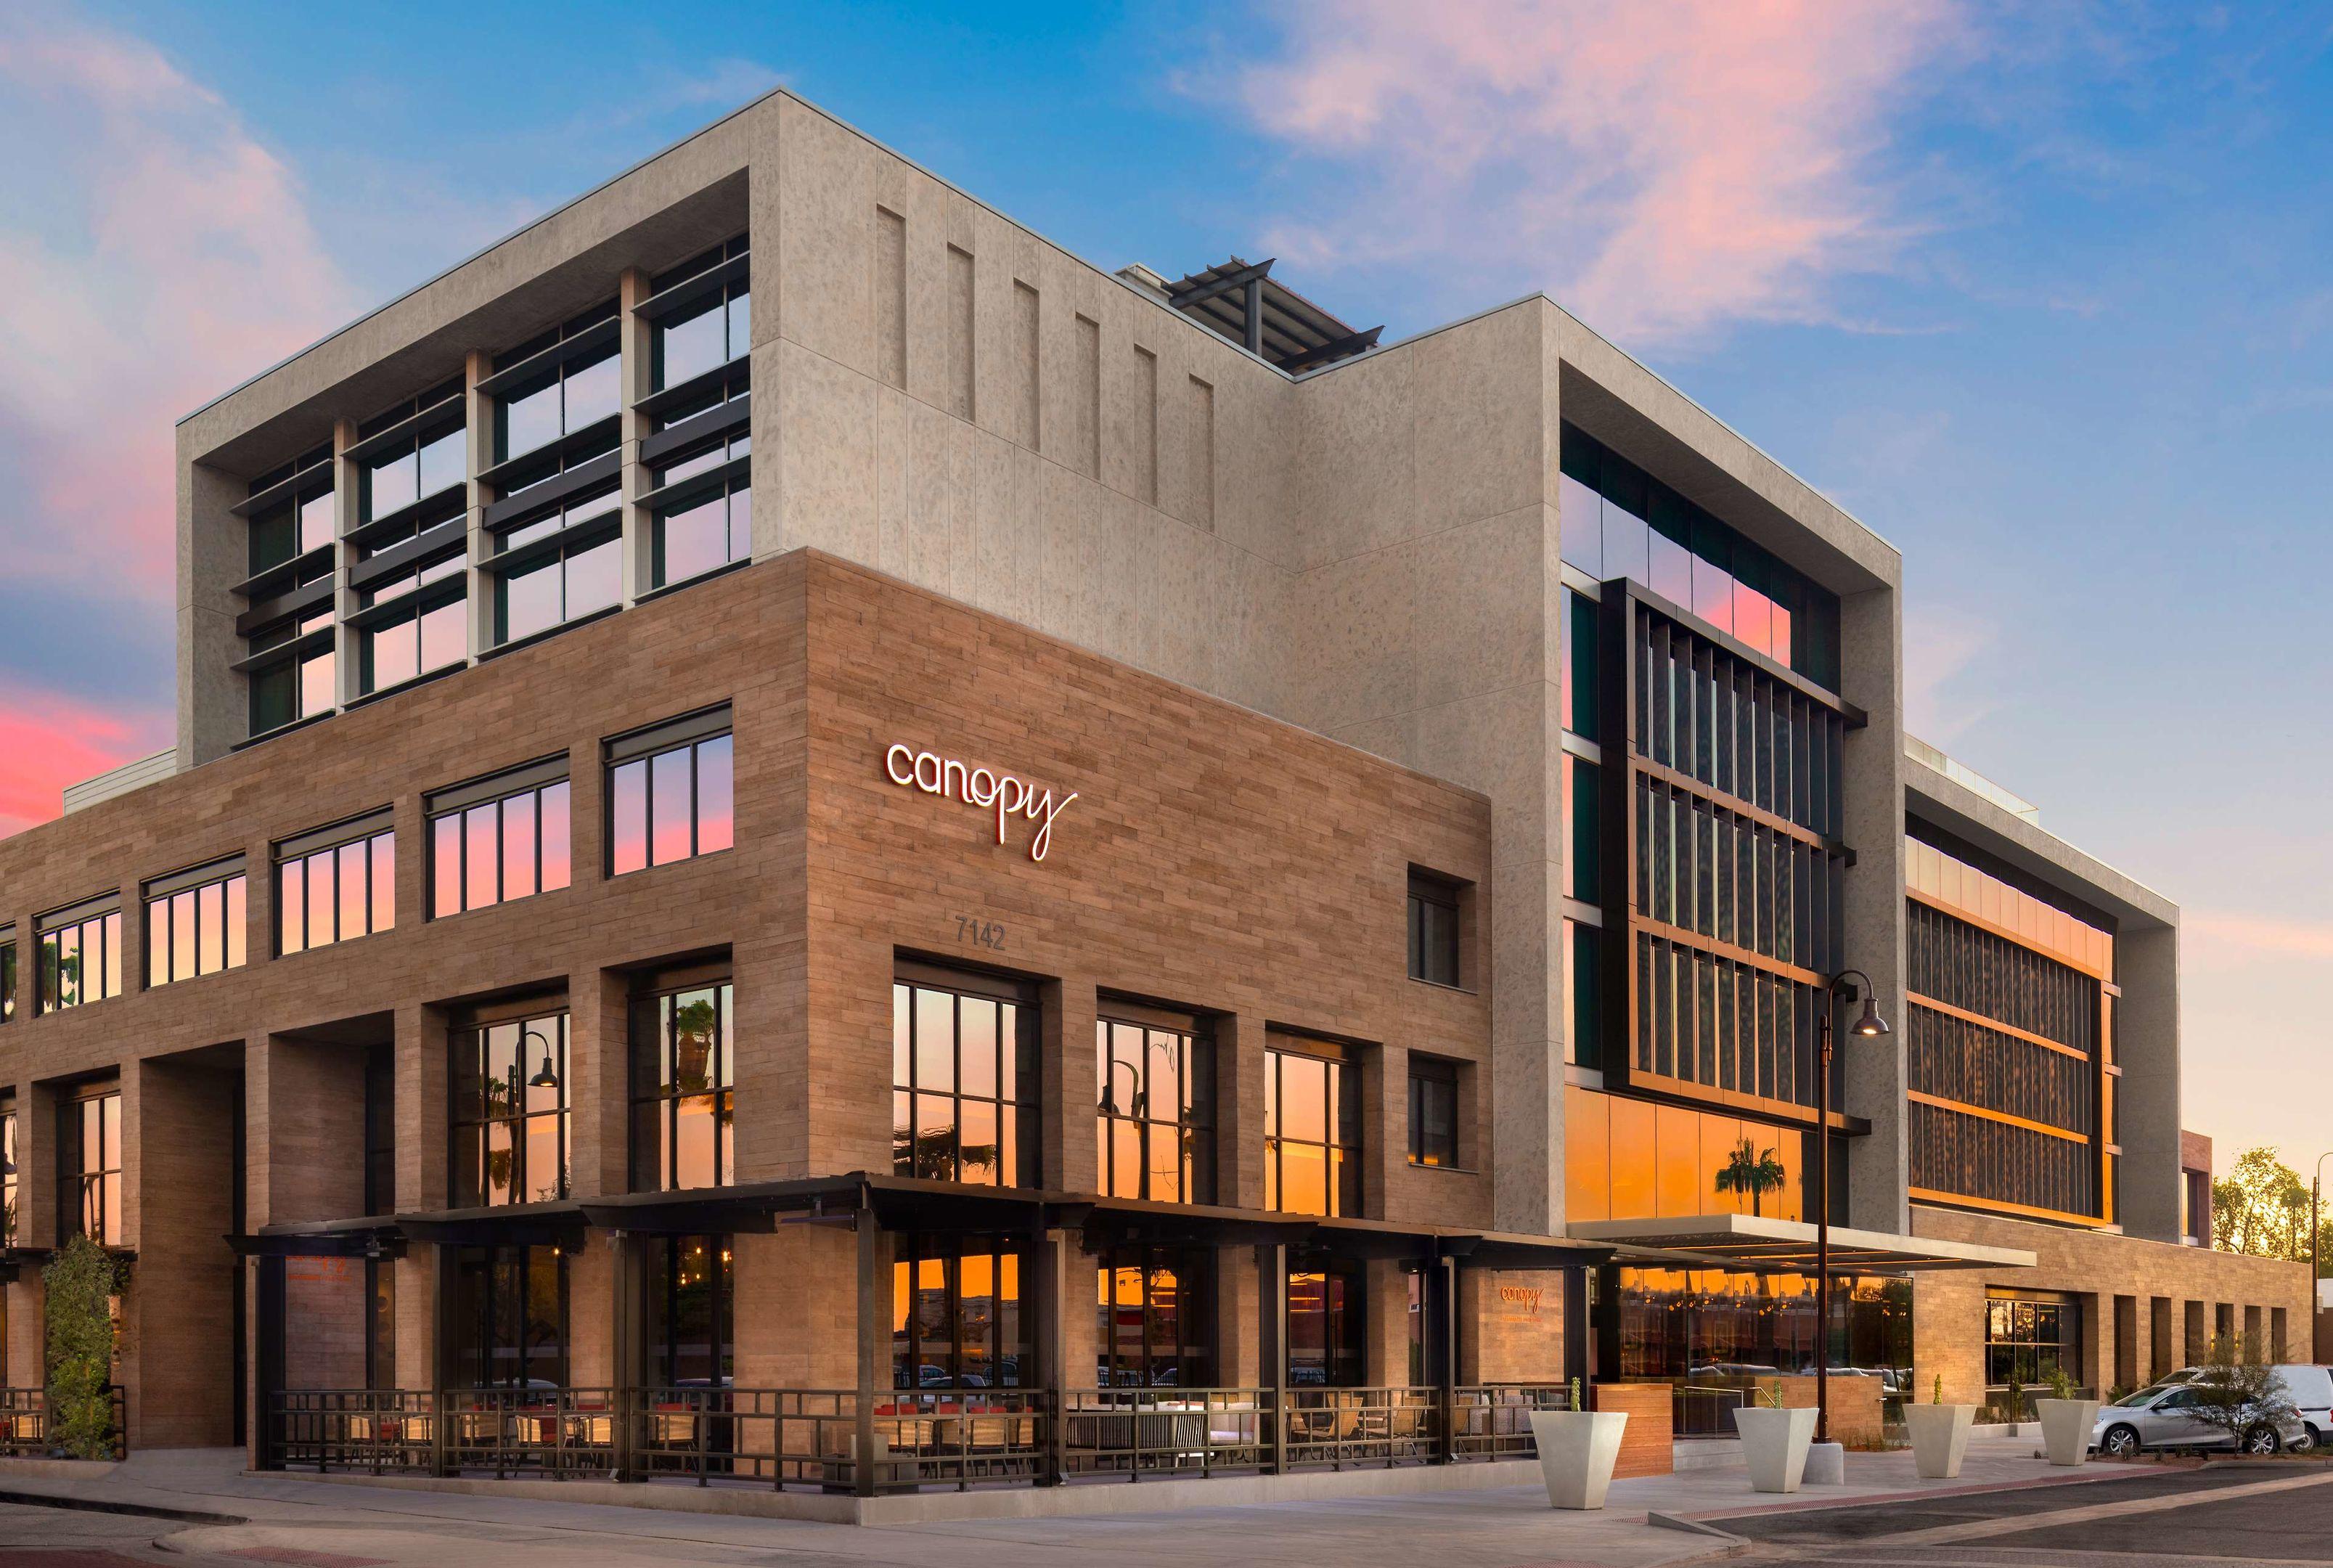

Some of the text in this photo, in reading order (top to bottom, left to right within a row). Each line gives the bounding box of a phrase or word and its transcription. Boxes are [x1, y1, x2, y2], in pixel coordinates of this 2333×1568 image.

[883, 743, 1079, 862] canopy
[955, 915, 1006, 951] 7142
[1500, 1287, 1546, 1314] canopy
